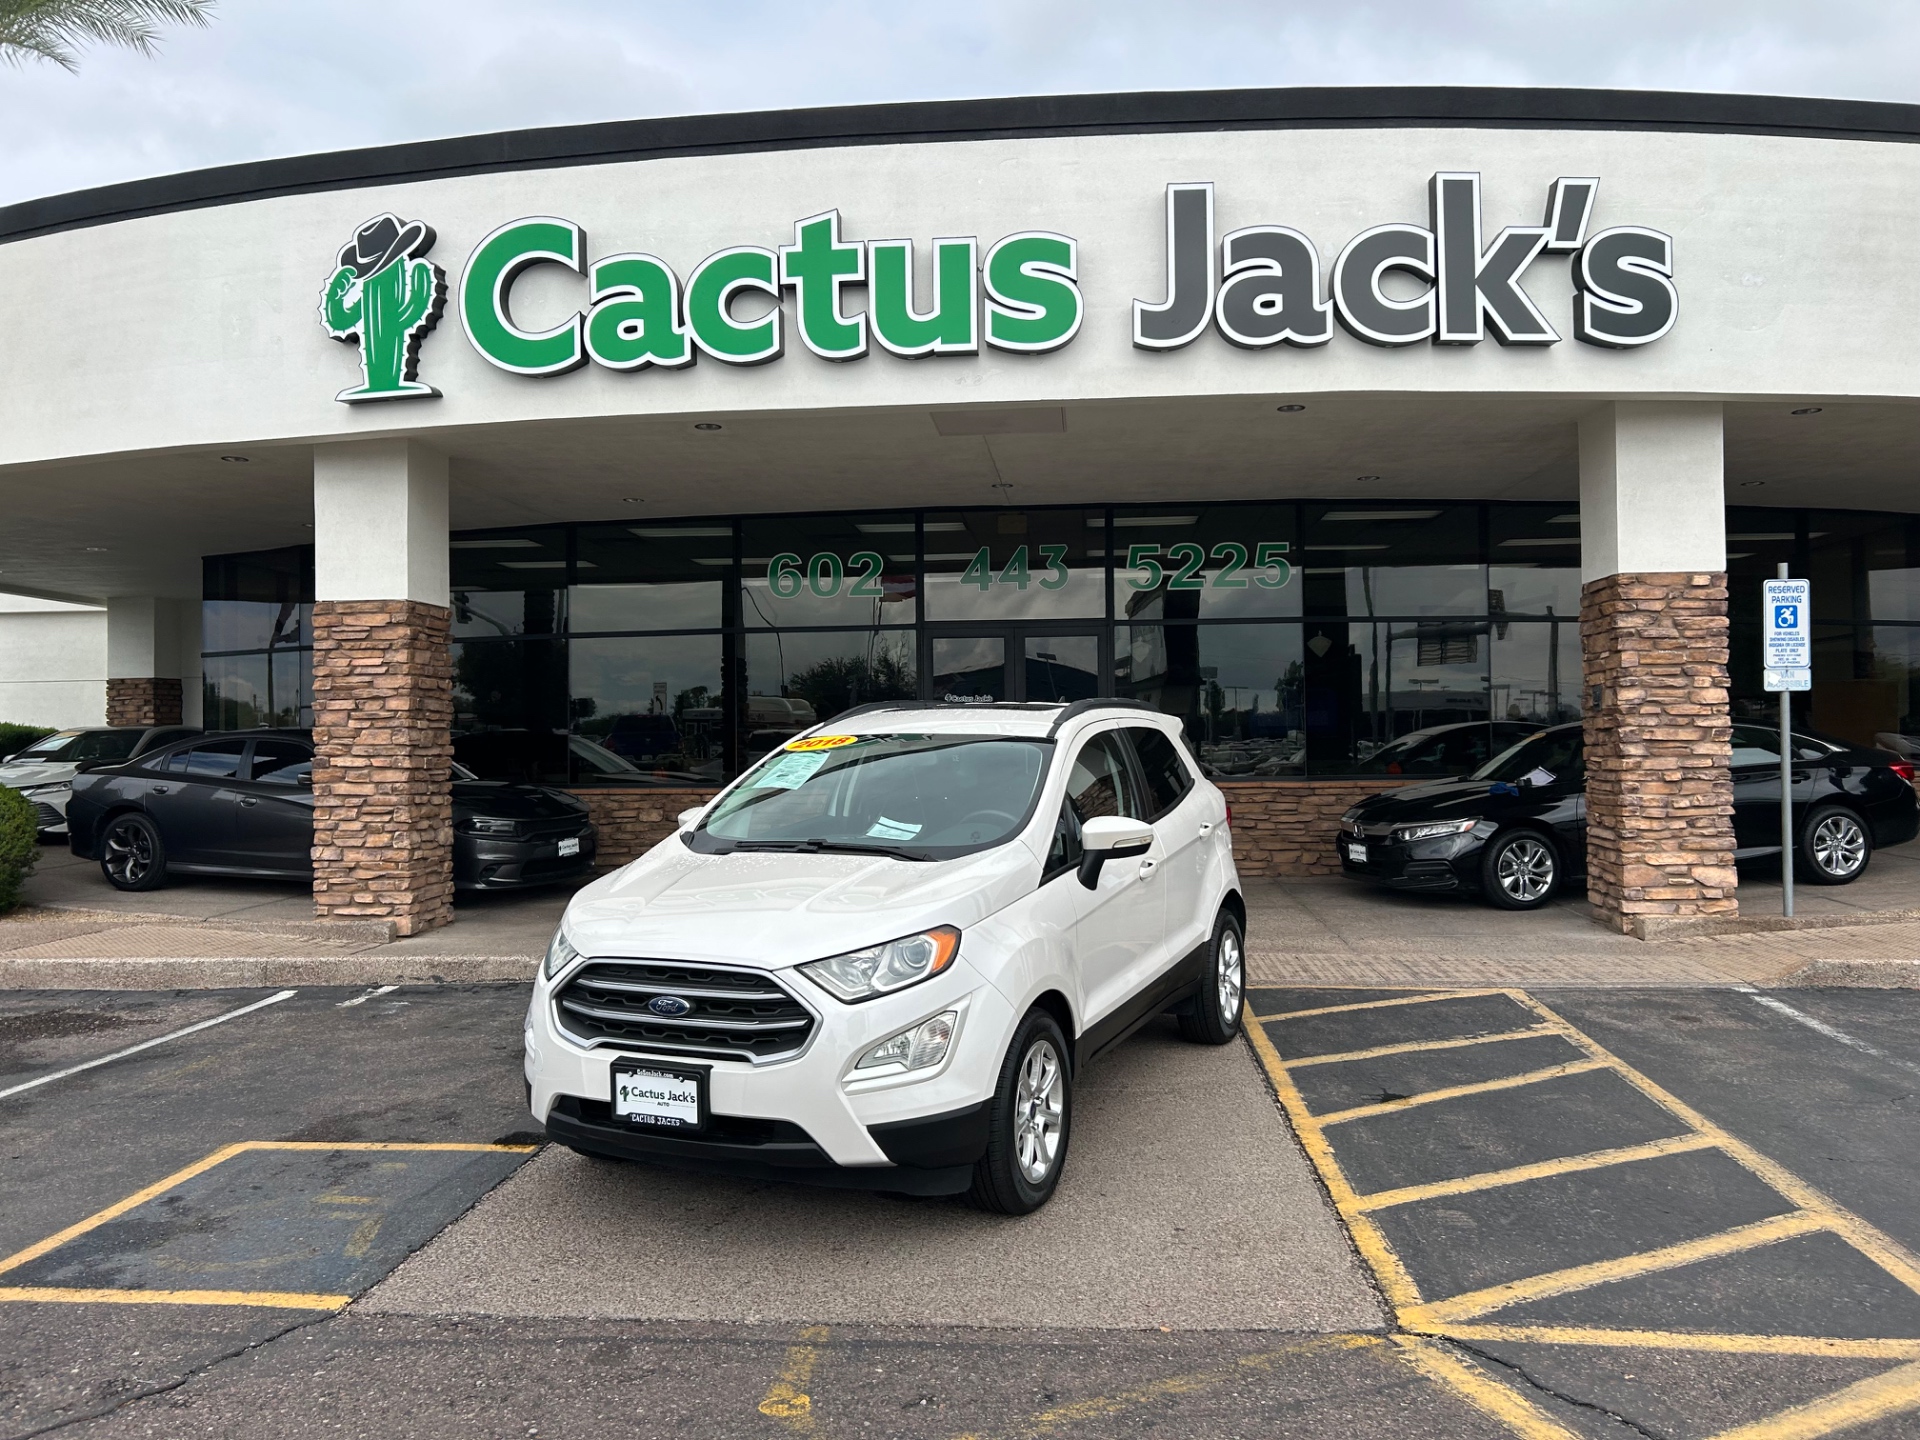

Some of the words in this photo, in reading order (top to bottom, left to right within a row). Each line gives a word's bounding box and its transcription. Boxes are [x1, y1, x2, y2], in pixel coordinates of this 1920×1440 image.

[458, 208, 1085, 377] Cactus
[1133, 171, 1680, 350] Jack's
[767, 551, 885, 599] 602
[958, 543, 1070, 593] 443
[1125, 541, 1293, 591] 5225
[1768, 585, 1805, 594] RESERVED
[1771, 595, 1802, 604] PARKING
[1780, 671, 1795, 679] VAN
[790, 737, 851, 749] 2018
[656, 999, 679, 1011] Ford
[631, 1086, 665, 1100] Cactus
[667, 1090, 696, 1104] Jack's
[631, 1113, 655, 1124] CACTUS
[656, 1117, 680, 1127] JACKS
